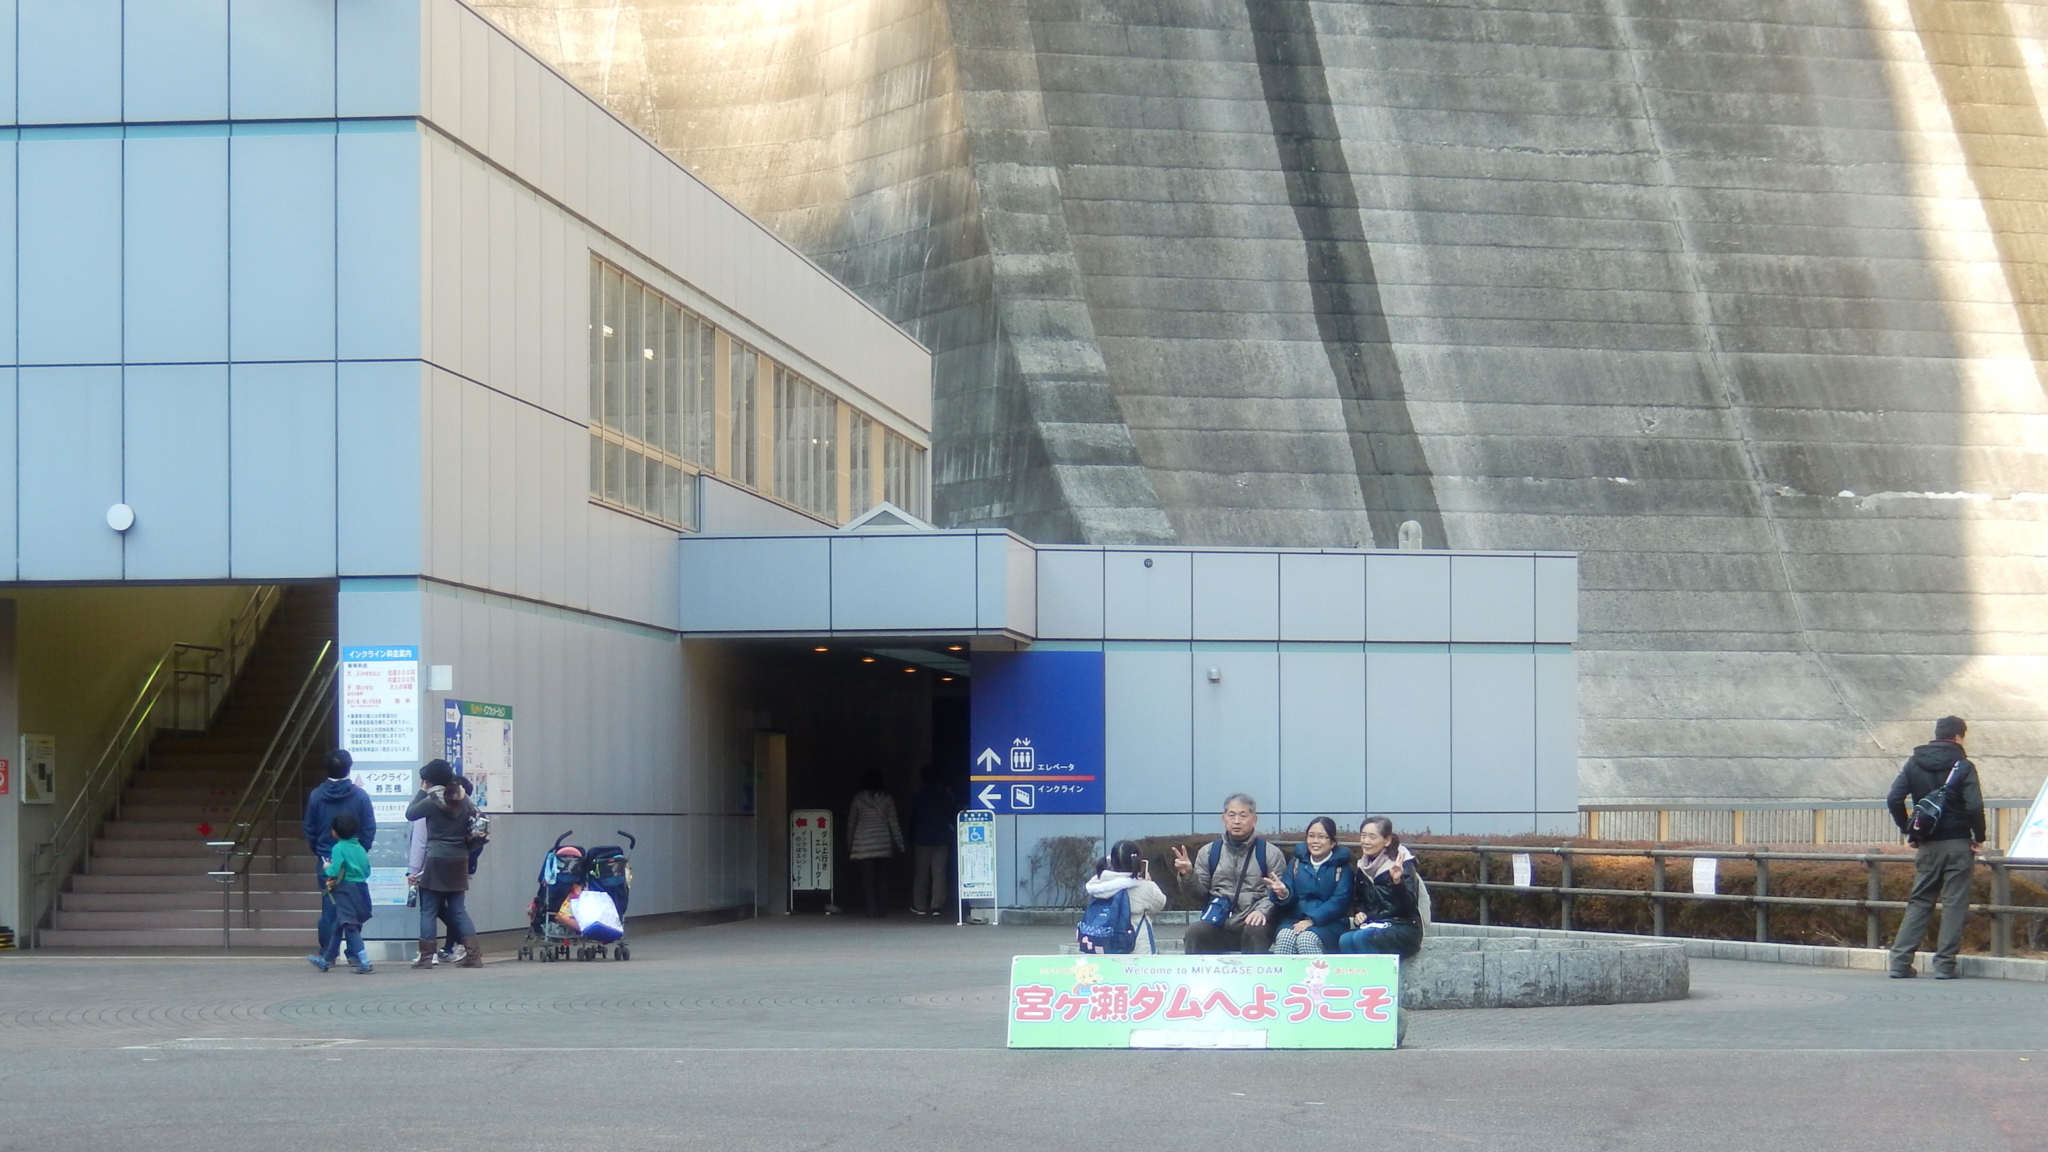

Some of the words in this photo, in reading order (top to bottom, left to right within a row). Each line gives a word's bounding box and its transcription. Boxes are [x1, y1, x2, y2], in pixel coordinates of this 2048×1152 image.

[349, 650, 412, 658] インクライン料金案内
[367, 773, 410, 781] インクライン
[1038, 785, 1084, 793] インクライン
[1124, 966, 1172, 974] Welcome
[1191, 966, 1253, 975] MIYAGASE
[1257, 966, 1283, 975] DAM
